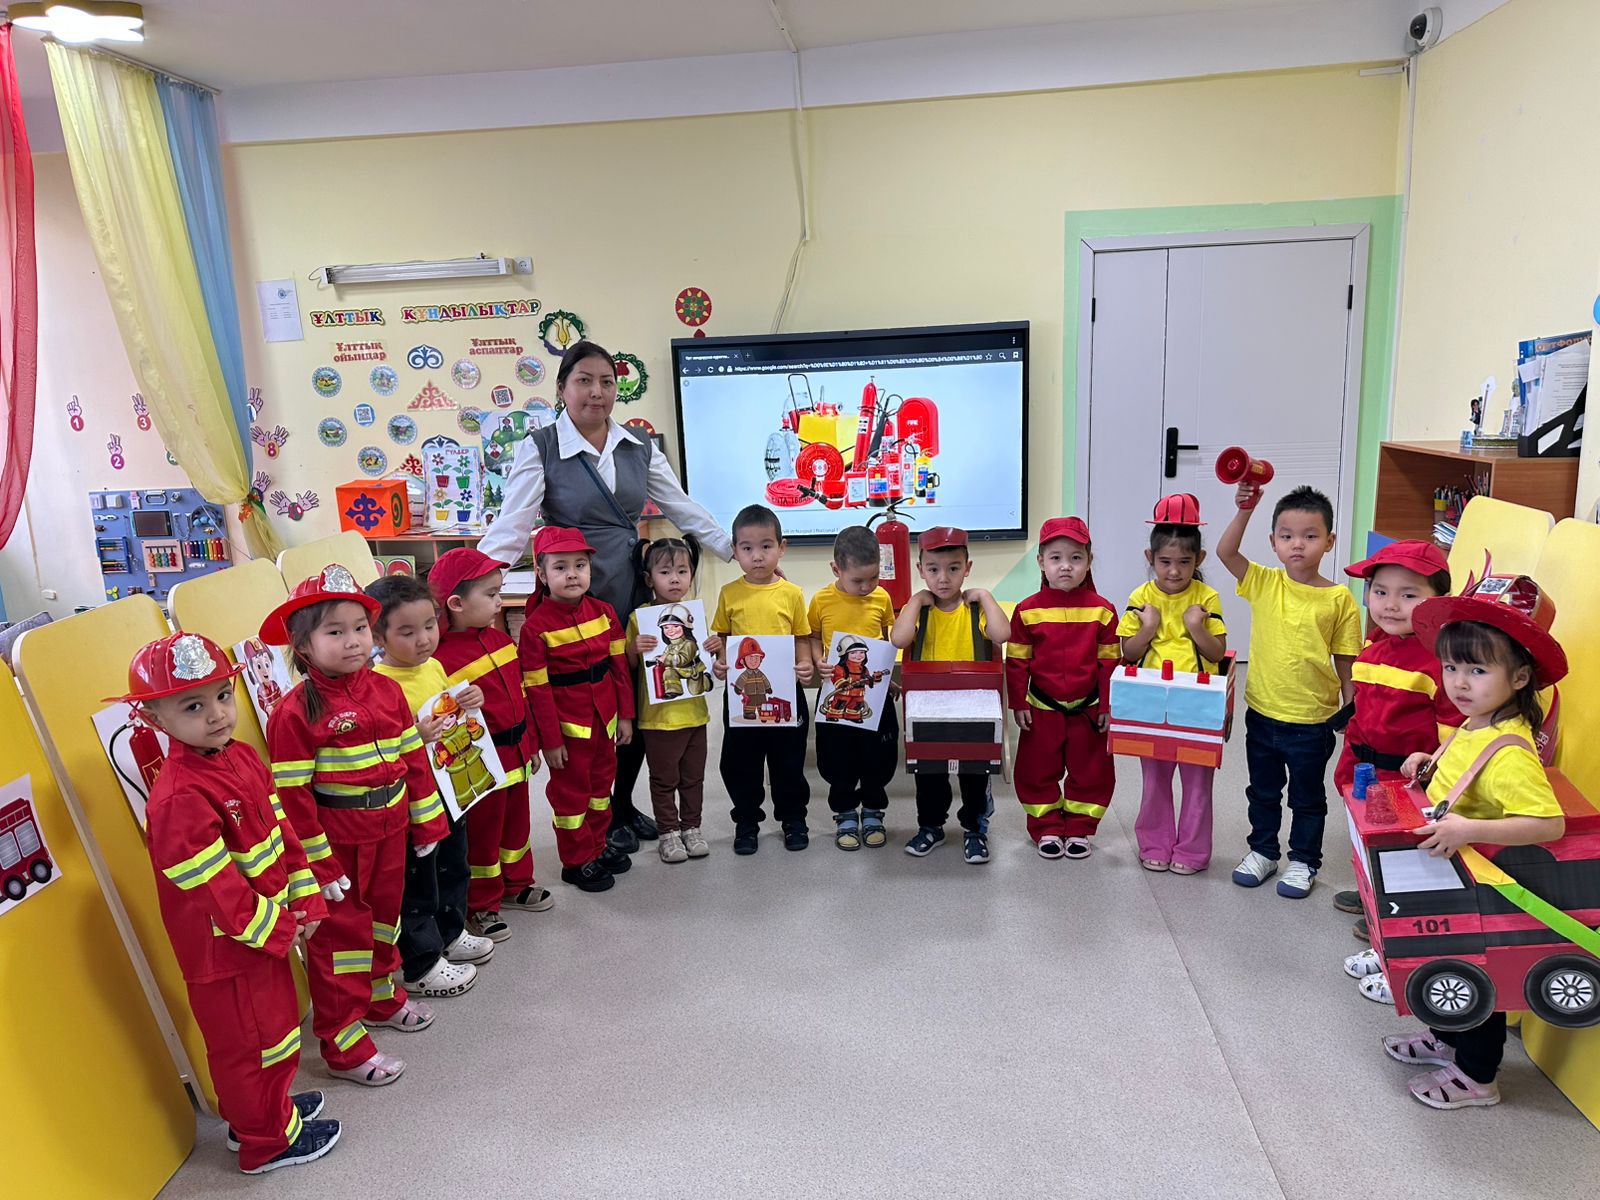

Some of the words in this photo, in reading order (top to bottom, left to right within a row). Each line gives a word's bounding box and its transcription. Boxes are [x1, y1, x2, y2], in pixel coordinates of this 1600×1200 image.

[73, 418, 80, 429] 1
[140, 417, 147, 428] 3
[267, 442, 277, 457] 8
[113, 456, 121, 467] 2
[1412, 918, 1451, 934] 101
[424, 984, 465, 997] crocs
